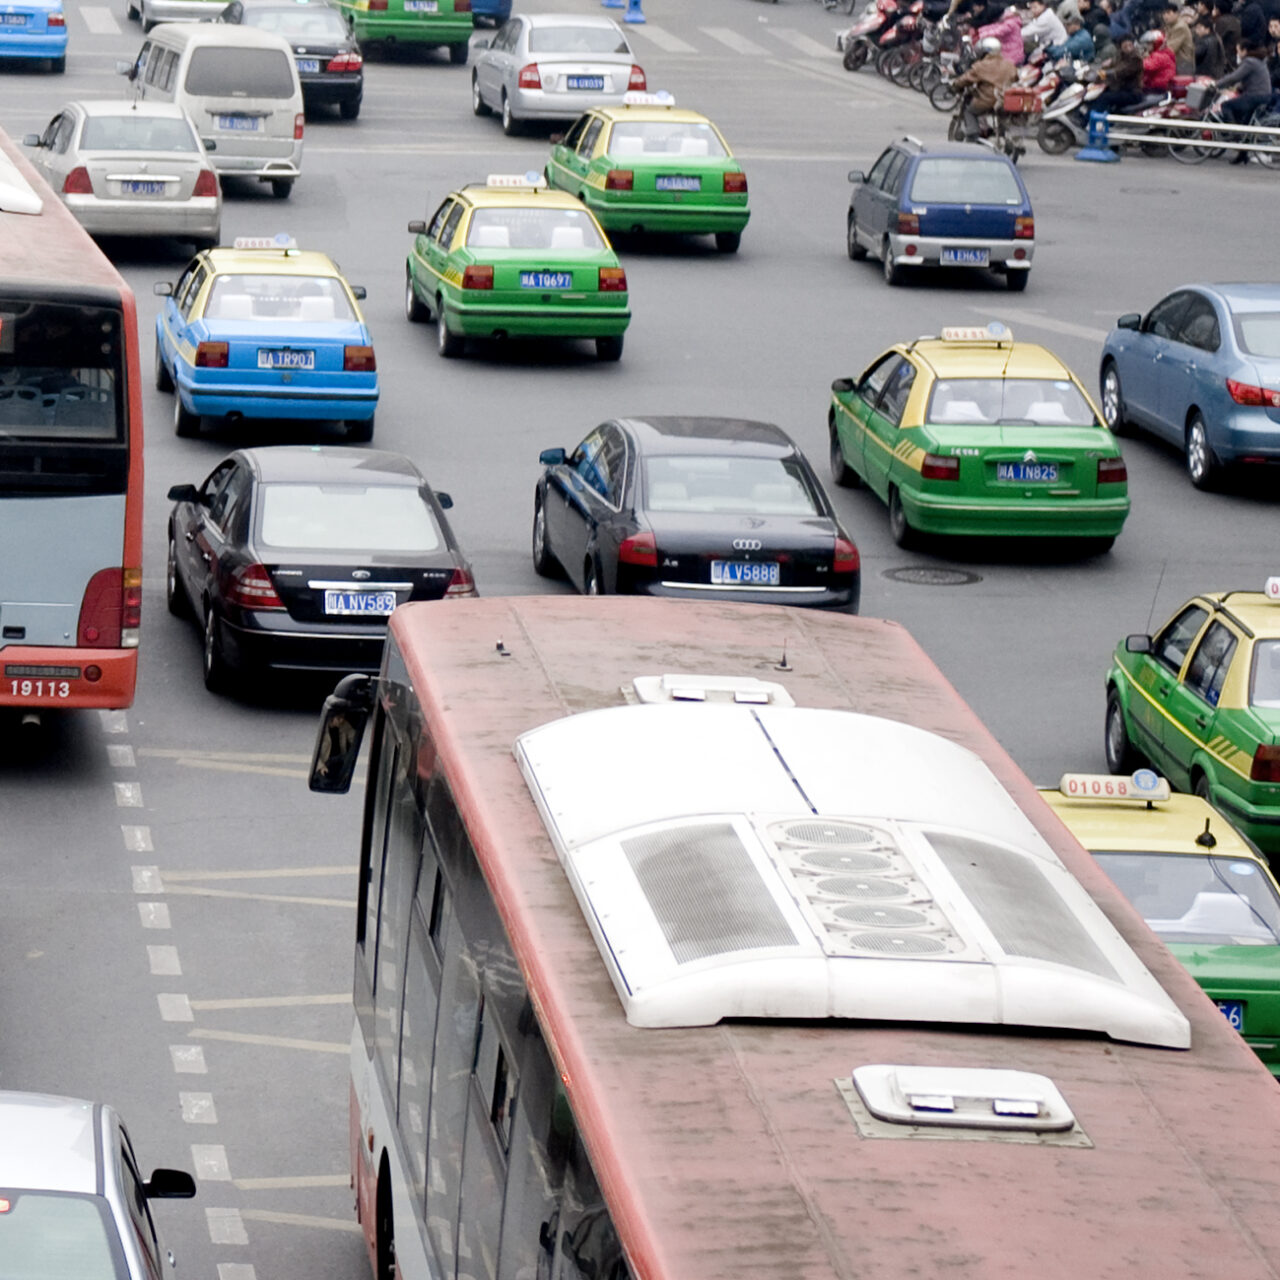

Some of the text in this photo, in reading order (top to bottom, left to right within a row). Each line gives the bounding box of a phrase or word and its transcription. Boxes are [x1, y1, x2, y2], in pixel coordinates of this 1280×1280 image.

[1019, 465, 1058, 481] TN825
[734, 564, 778, 582] V5888
[348, 594, 397, 613] NV589
[11, 680, 70, 698] 19113
[1068, 779, 1128, 797] 01068
